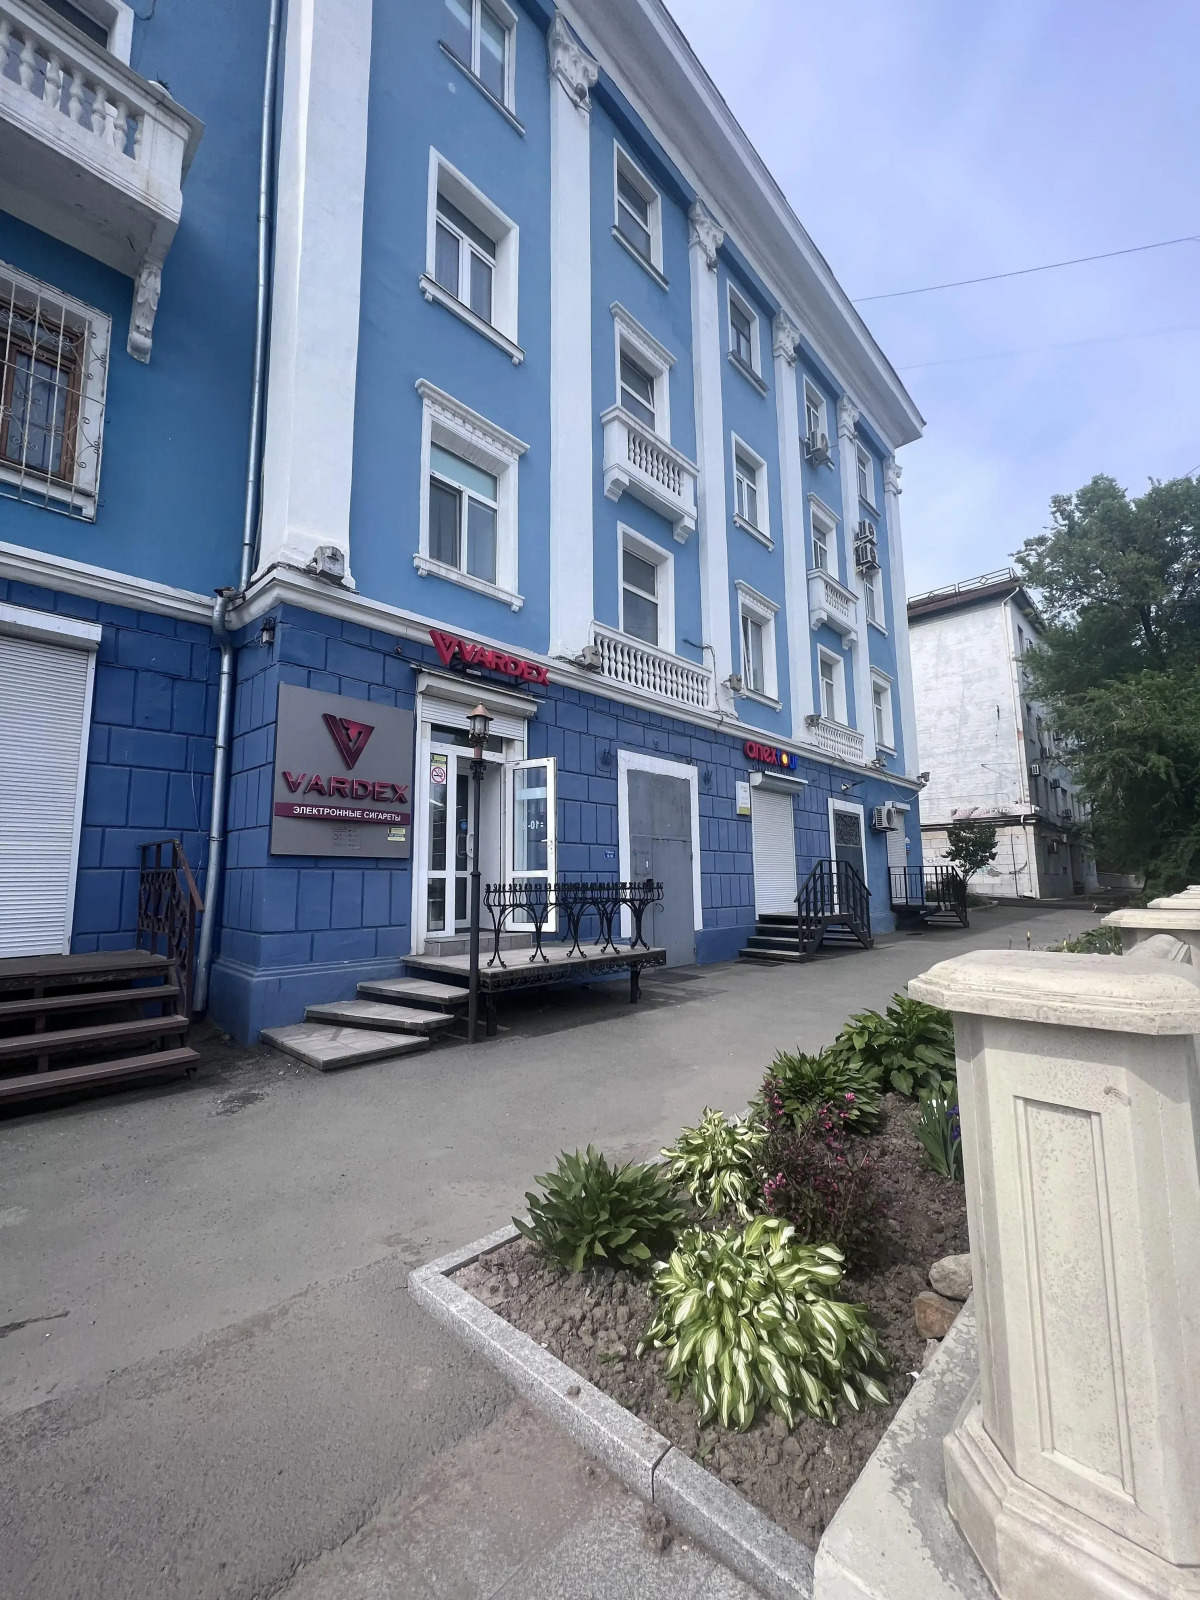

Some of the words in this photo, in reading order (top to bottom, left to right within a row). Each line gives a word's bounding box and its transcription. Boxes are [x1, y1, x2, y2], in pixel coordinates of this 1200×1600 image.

[457, 640, 550, 687] VARDEX
[282, 771, 409, 803] VARDEX
[293, 806, 362, 818] ЭЛЕКТРОННЫЕ
[363, 811, 401, 822] СИГАРЕТЫ
